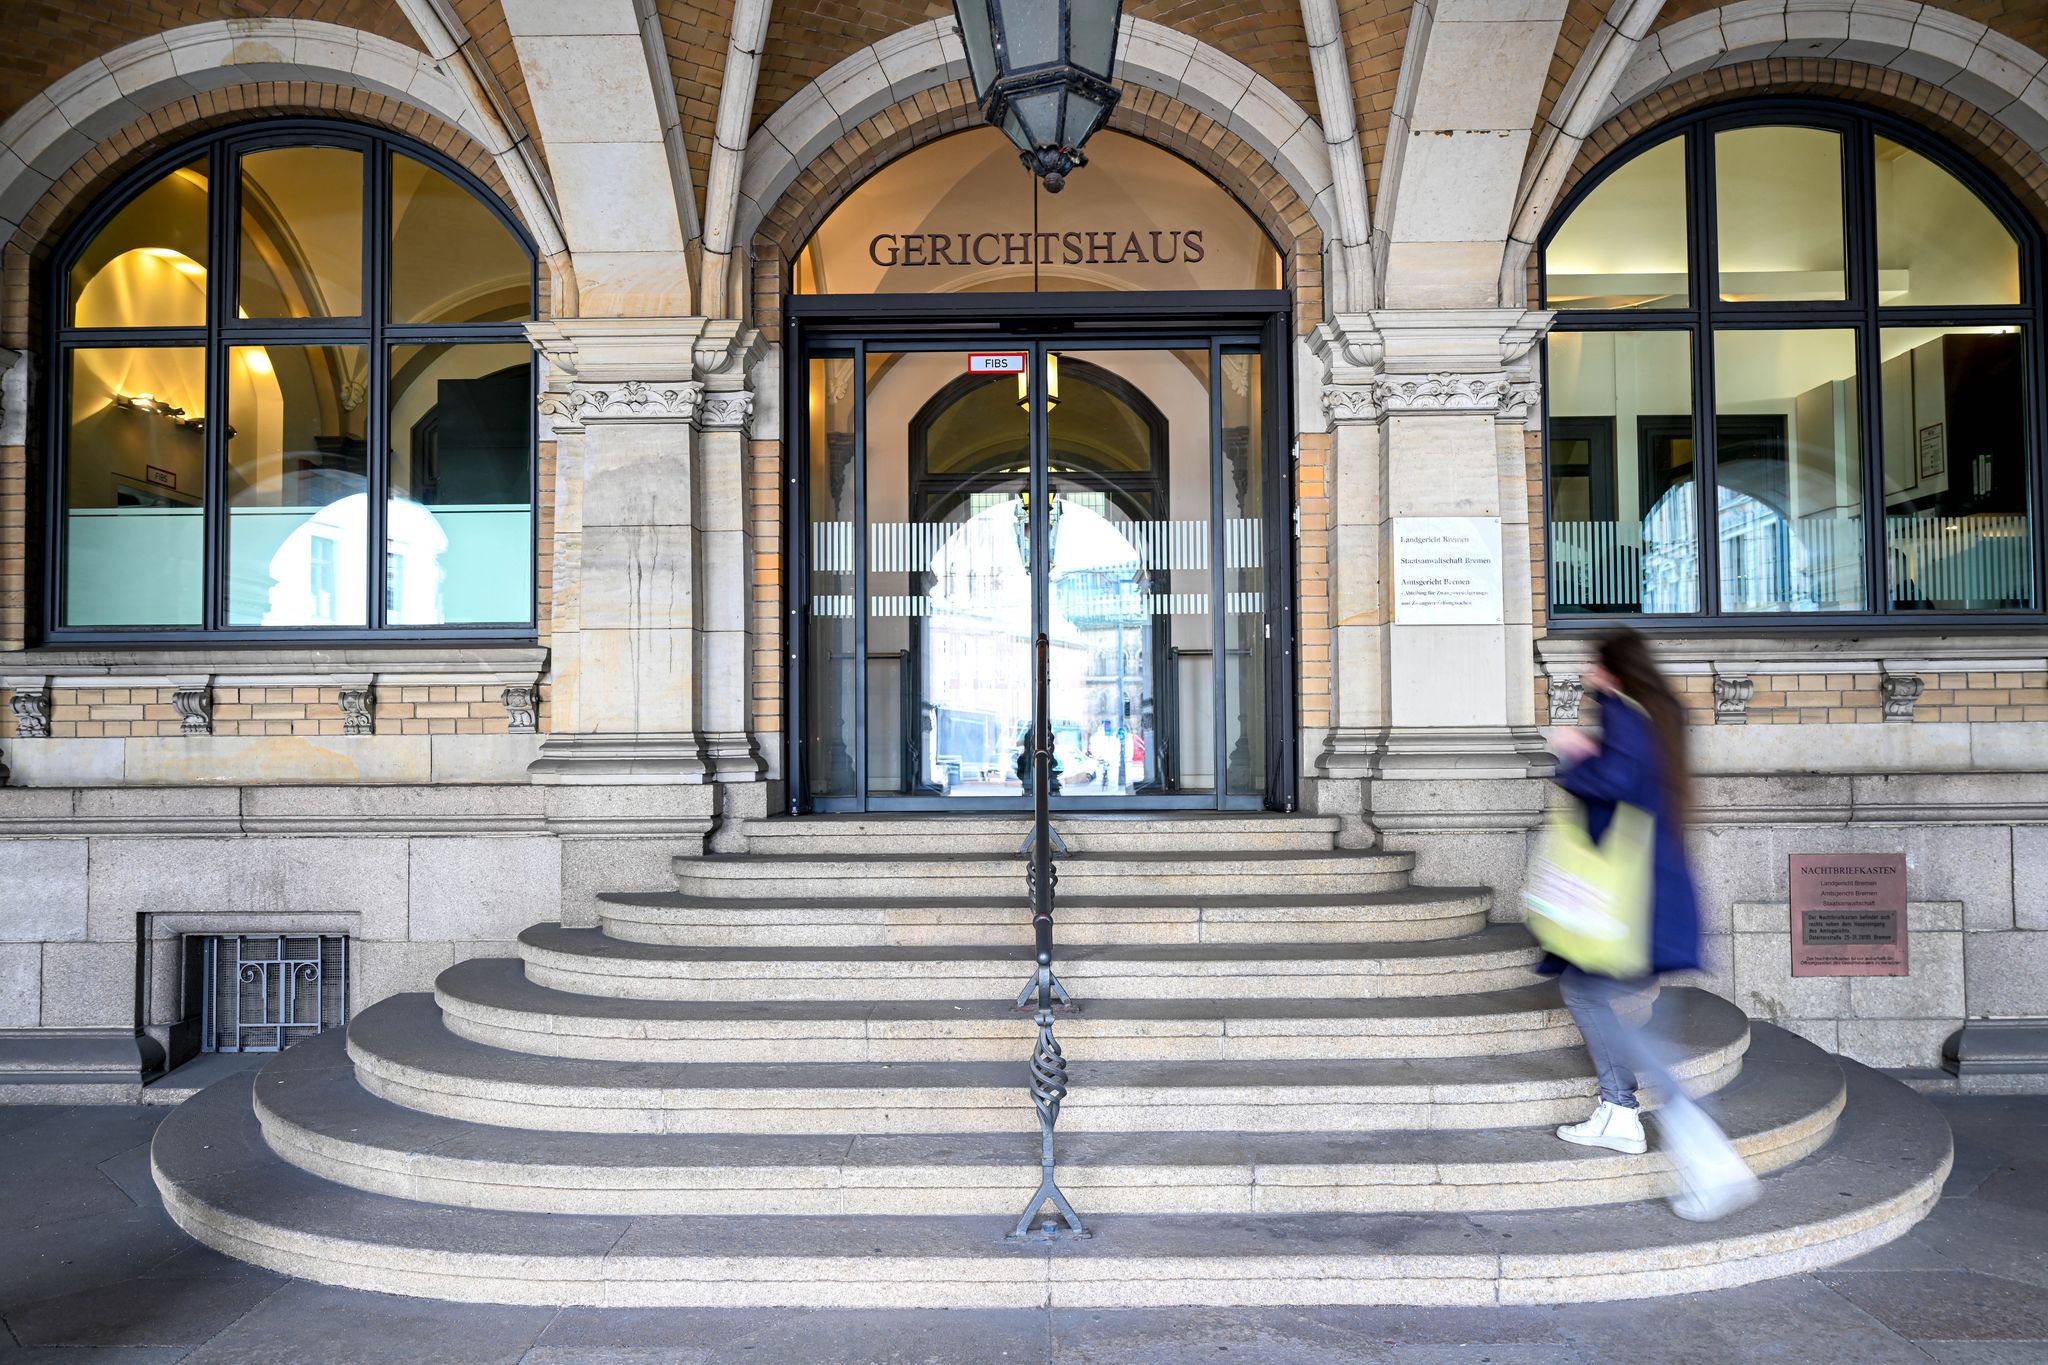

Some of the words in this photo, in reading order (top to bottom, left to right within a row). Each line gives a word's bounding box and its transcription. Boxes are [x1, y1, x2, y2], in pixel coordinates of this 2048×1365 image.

[869, 230, 1205, 267] GERICHTSHAUS
[985, 359, 1008, 368] FIBS
[155, 472, 168, 482] FIBS
[1401, 578, 1442, 586] Amtsgericht
[1801, 866, 1896, 875] NACHTBRIEFKASTEN
